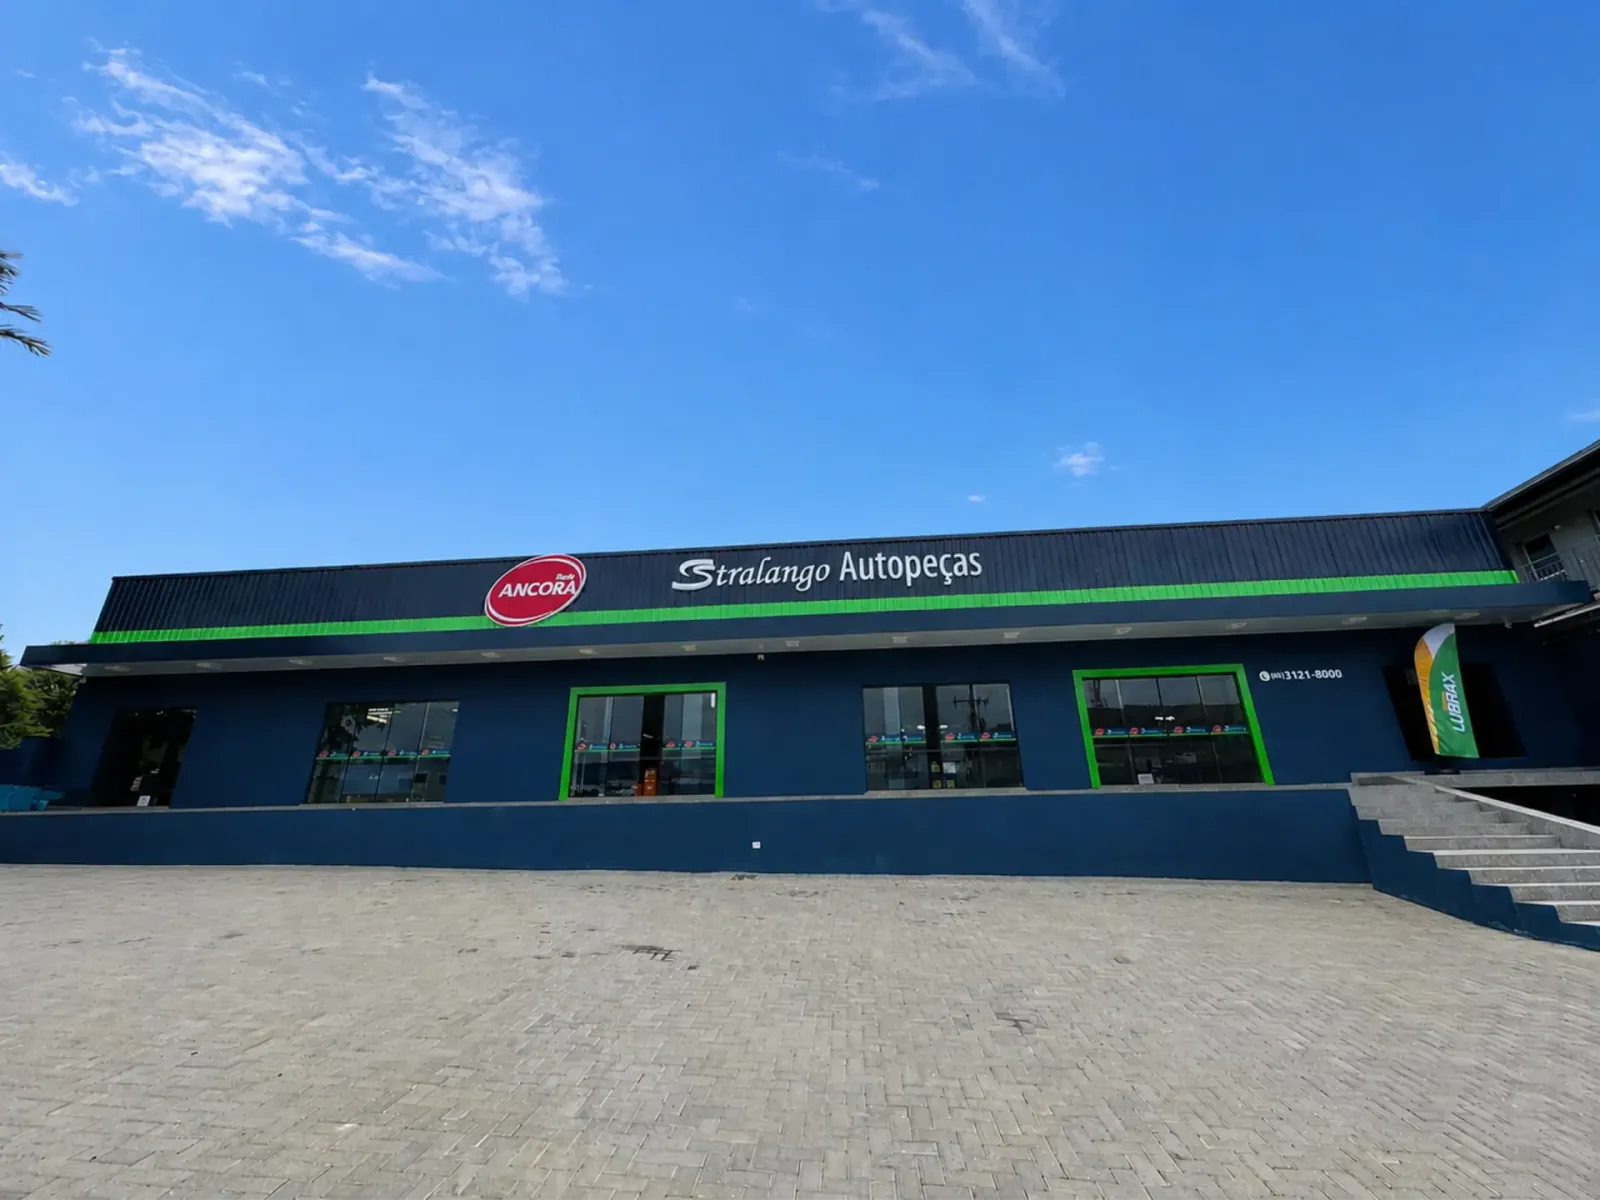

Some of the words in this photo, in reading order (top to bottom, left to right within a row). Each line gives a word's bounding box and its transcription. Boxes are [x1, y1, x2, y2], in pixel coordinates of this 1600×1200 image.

[498, 580, 576, 598] ANCORA
[671, 556, 831, 592] Stralango
[839, 551, 983, 586] Autopeças
[1441, 672, 1465, 732] LUBRAX
